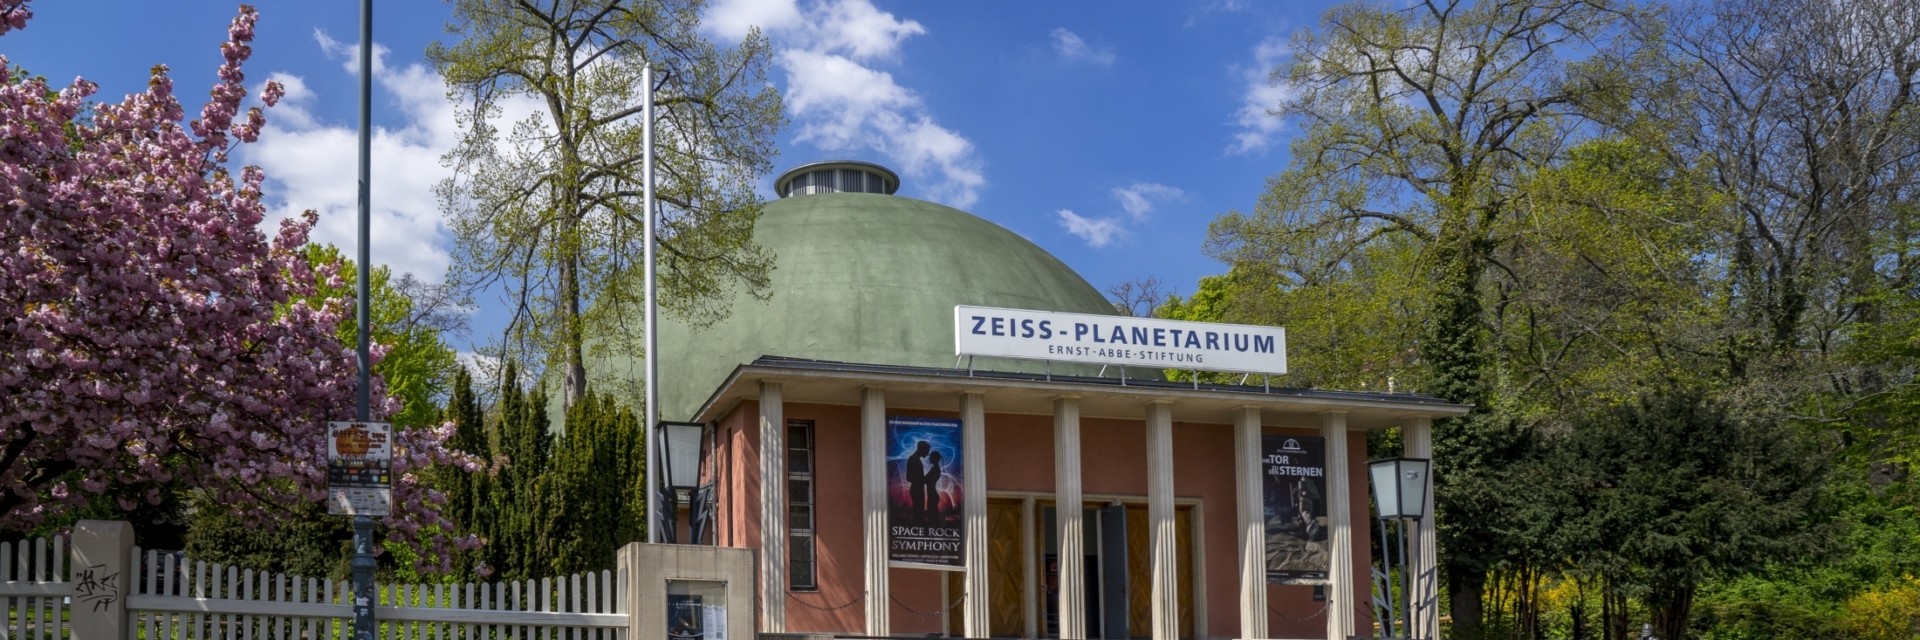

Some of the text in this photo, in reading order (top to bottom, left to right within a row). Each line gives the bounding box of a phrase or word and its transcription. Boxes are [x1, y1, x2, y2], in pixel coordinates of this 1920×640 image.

[1049, 345, 1203, 363] ERNST-ABBE-STIFTUNG
[1269, 455, 1289, 464] TOR
[1280, 466, 1323, 476] STERNEN
[892, 526, 960, 537] SPACE ROCK
[892, 540, 960, 551] SYMPHONY
